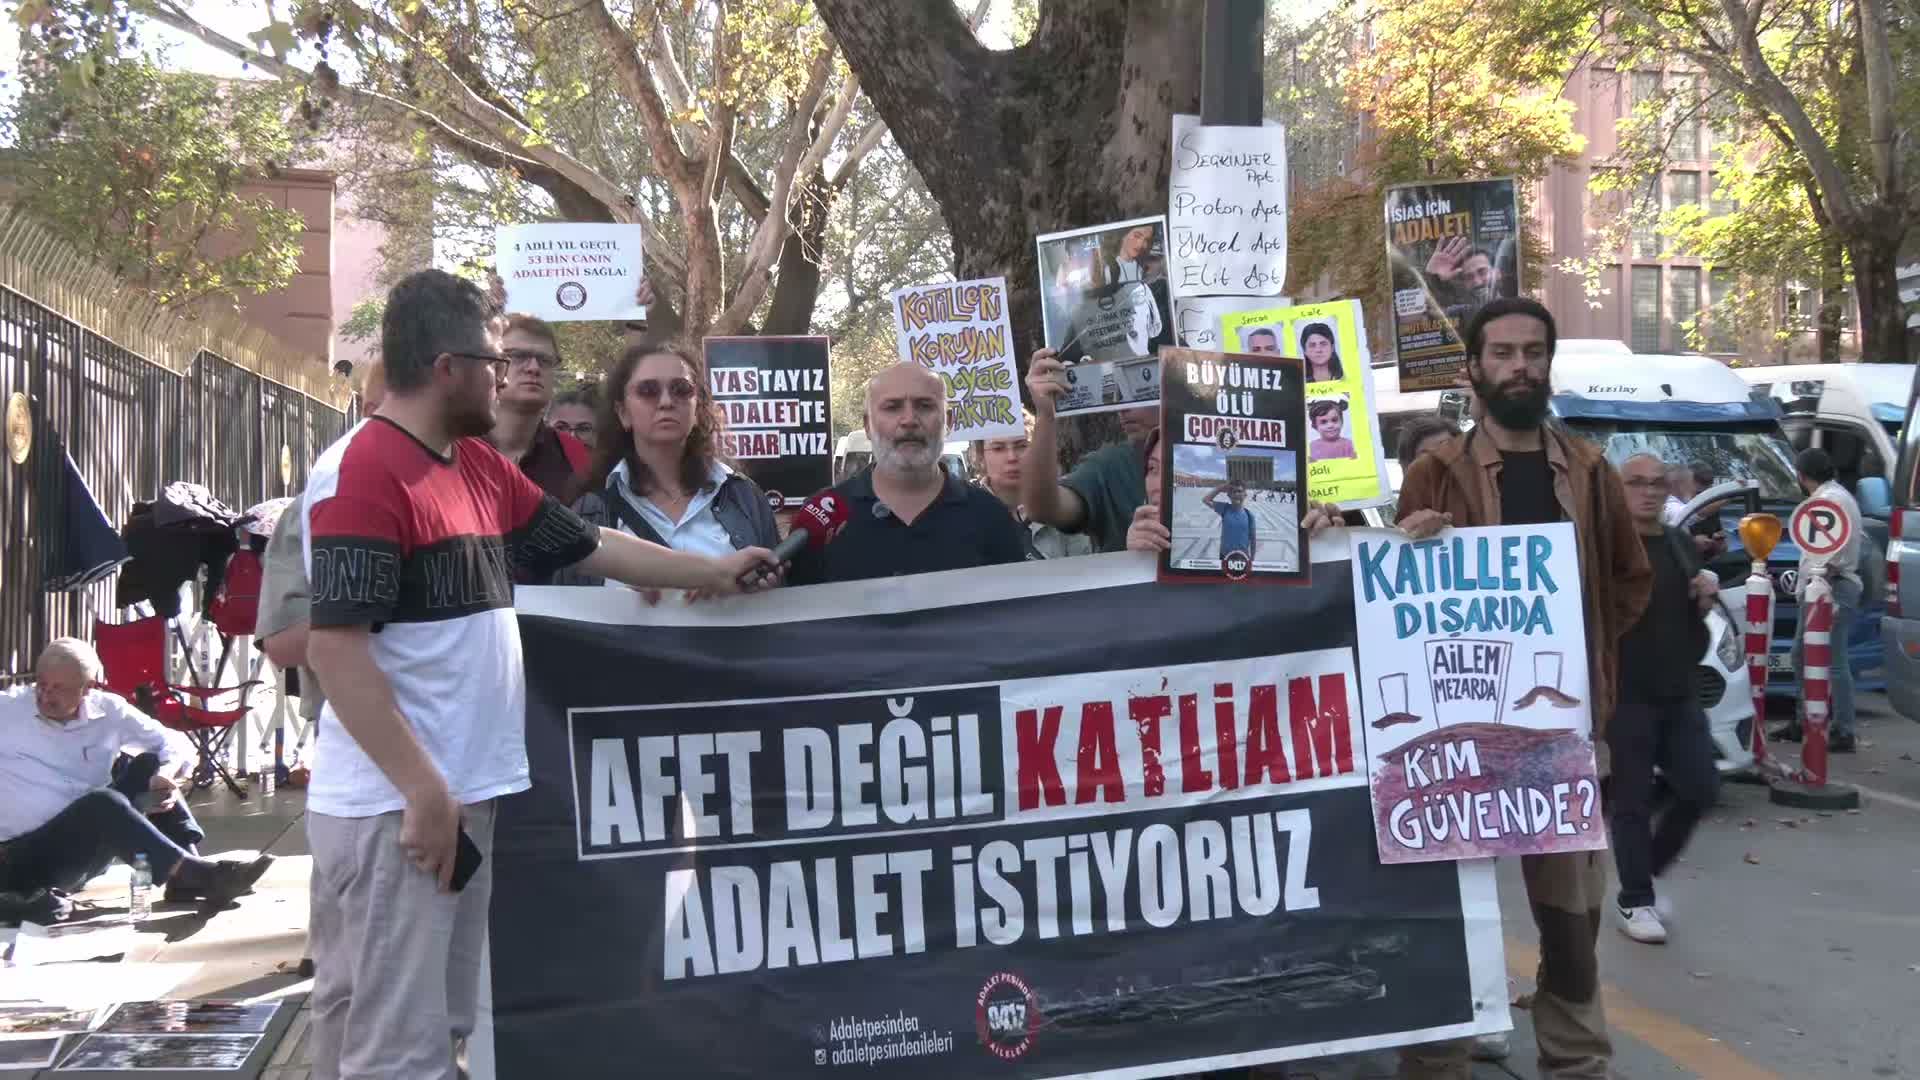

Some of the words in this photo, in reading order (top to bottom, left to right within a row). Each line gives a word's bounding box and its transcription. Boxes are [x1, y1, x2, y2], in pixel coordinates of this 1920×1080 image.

[1175, 192, 1243, 217] Proton
[1425, 198, 1451, 218] İÇİN
[1395, 211, 1471, 244] ADALET!
[514, 243, 521, 252] 4
[524, 240, 553, 251] ADLİ
[556, 240, 578, 250] YIL
[1251, 232, 1281, 254] Apt
[512, 266, 580, 278] ADALETİNİ
[528, 255, 542, 265] 53
[572, 255, 612, 264] CANIN
[1180, 264, 1230, 288] Elit
[1244, 264, 1280, 288] Apt
[713, 369, 824, 392] YASTAYIZ
[1186, 360, 1282, 391] BÜYÜMEZ
[1215, 389, 1254, 416] ÖLÜ
[1809, 510, 1834, 543] P
[1393, 596, 1553, 639] DIŞARIDA
[1433, 677, 1498, 703] MEZARDA
[591, 731, 762, 847] AFET
[1389, 779, 1596, 849] GÜVENDE?
[664, 848, 933, 980] ADALET
[978, 975, 1000, 1006] ADALET
[830, 1009, 919, 1041] Adaletpesindea
[832, 1030, 953, 1066] adaletpesindeaileleri
